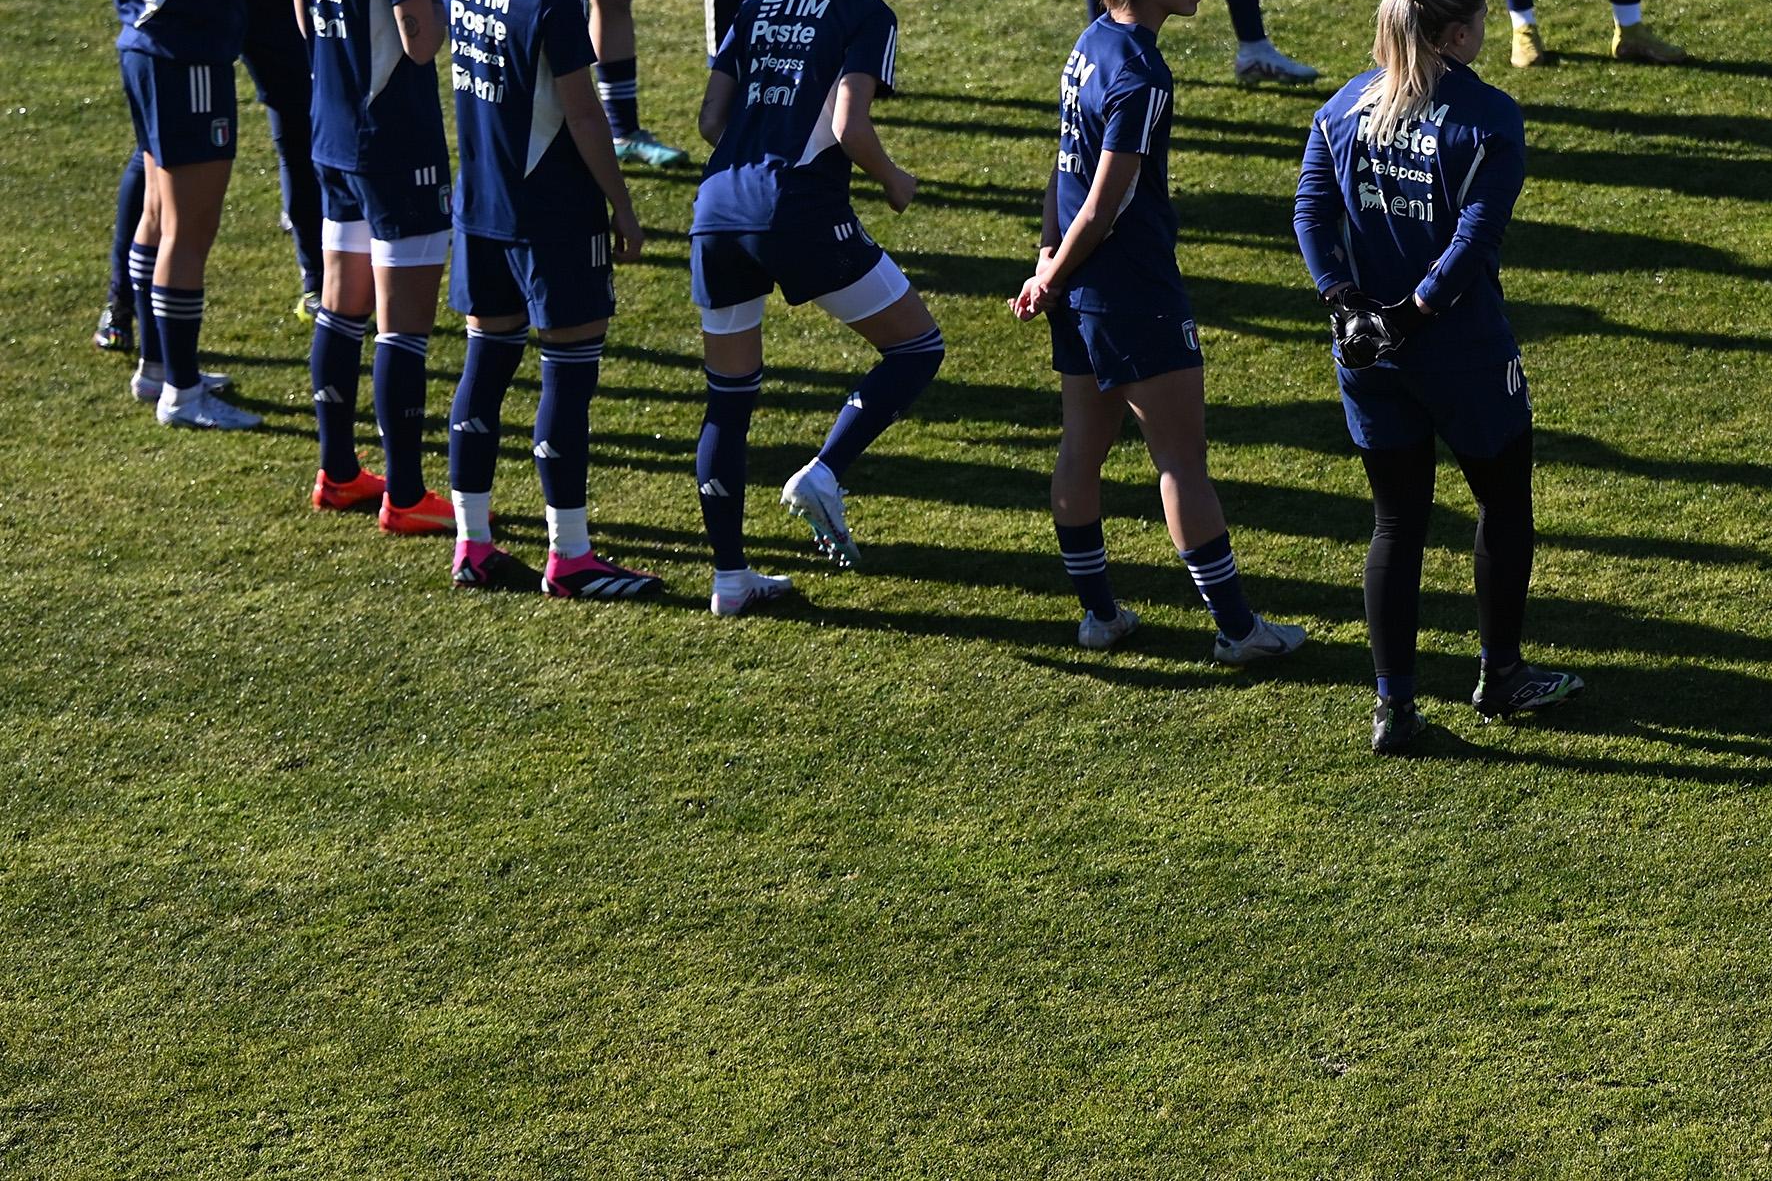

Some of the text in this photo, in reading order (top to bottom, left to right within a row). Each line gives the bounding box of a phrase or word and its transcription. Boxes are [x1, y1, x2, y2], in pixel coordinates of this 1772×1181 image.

[450, 0, 507, 41] Poste
[750, 20, 816, 45] Poste
[764, 78, 800, 107] eni
[1371, 158, 1434, 184] Telepass
[1390, 193, 1434, 222] eni
